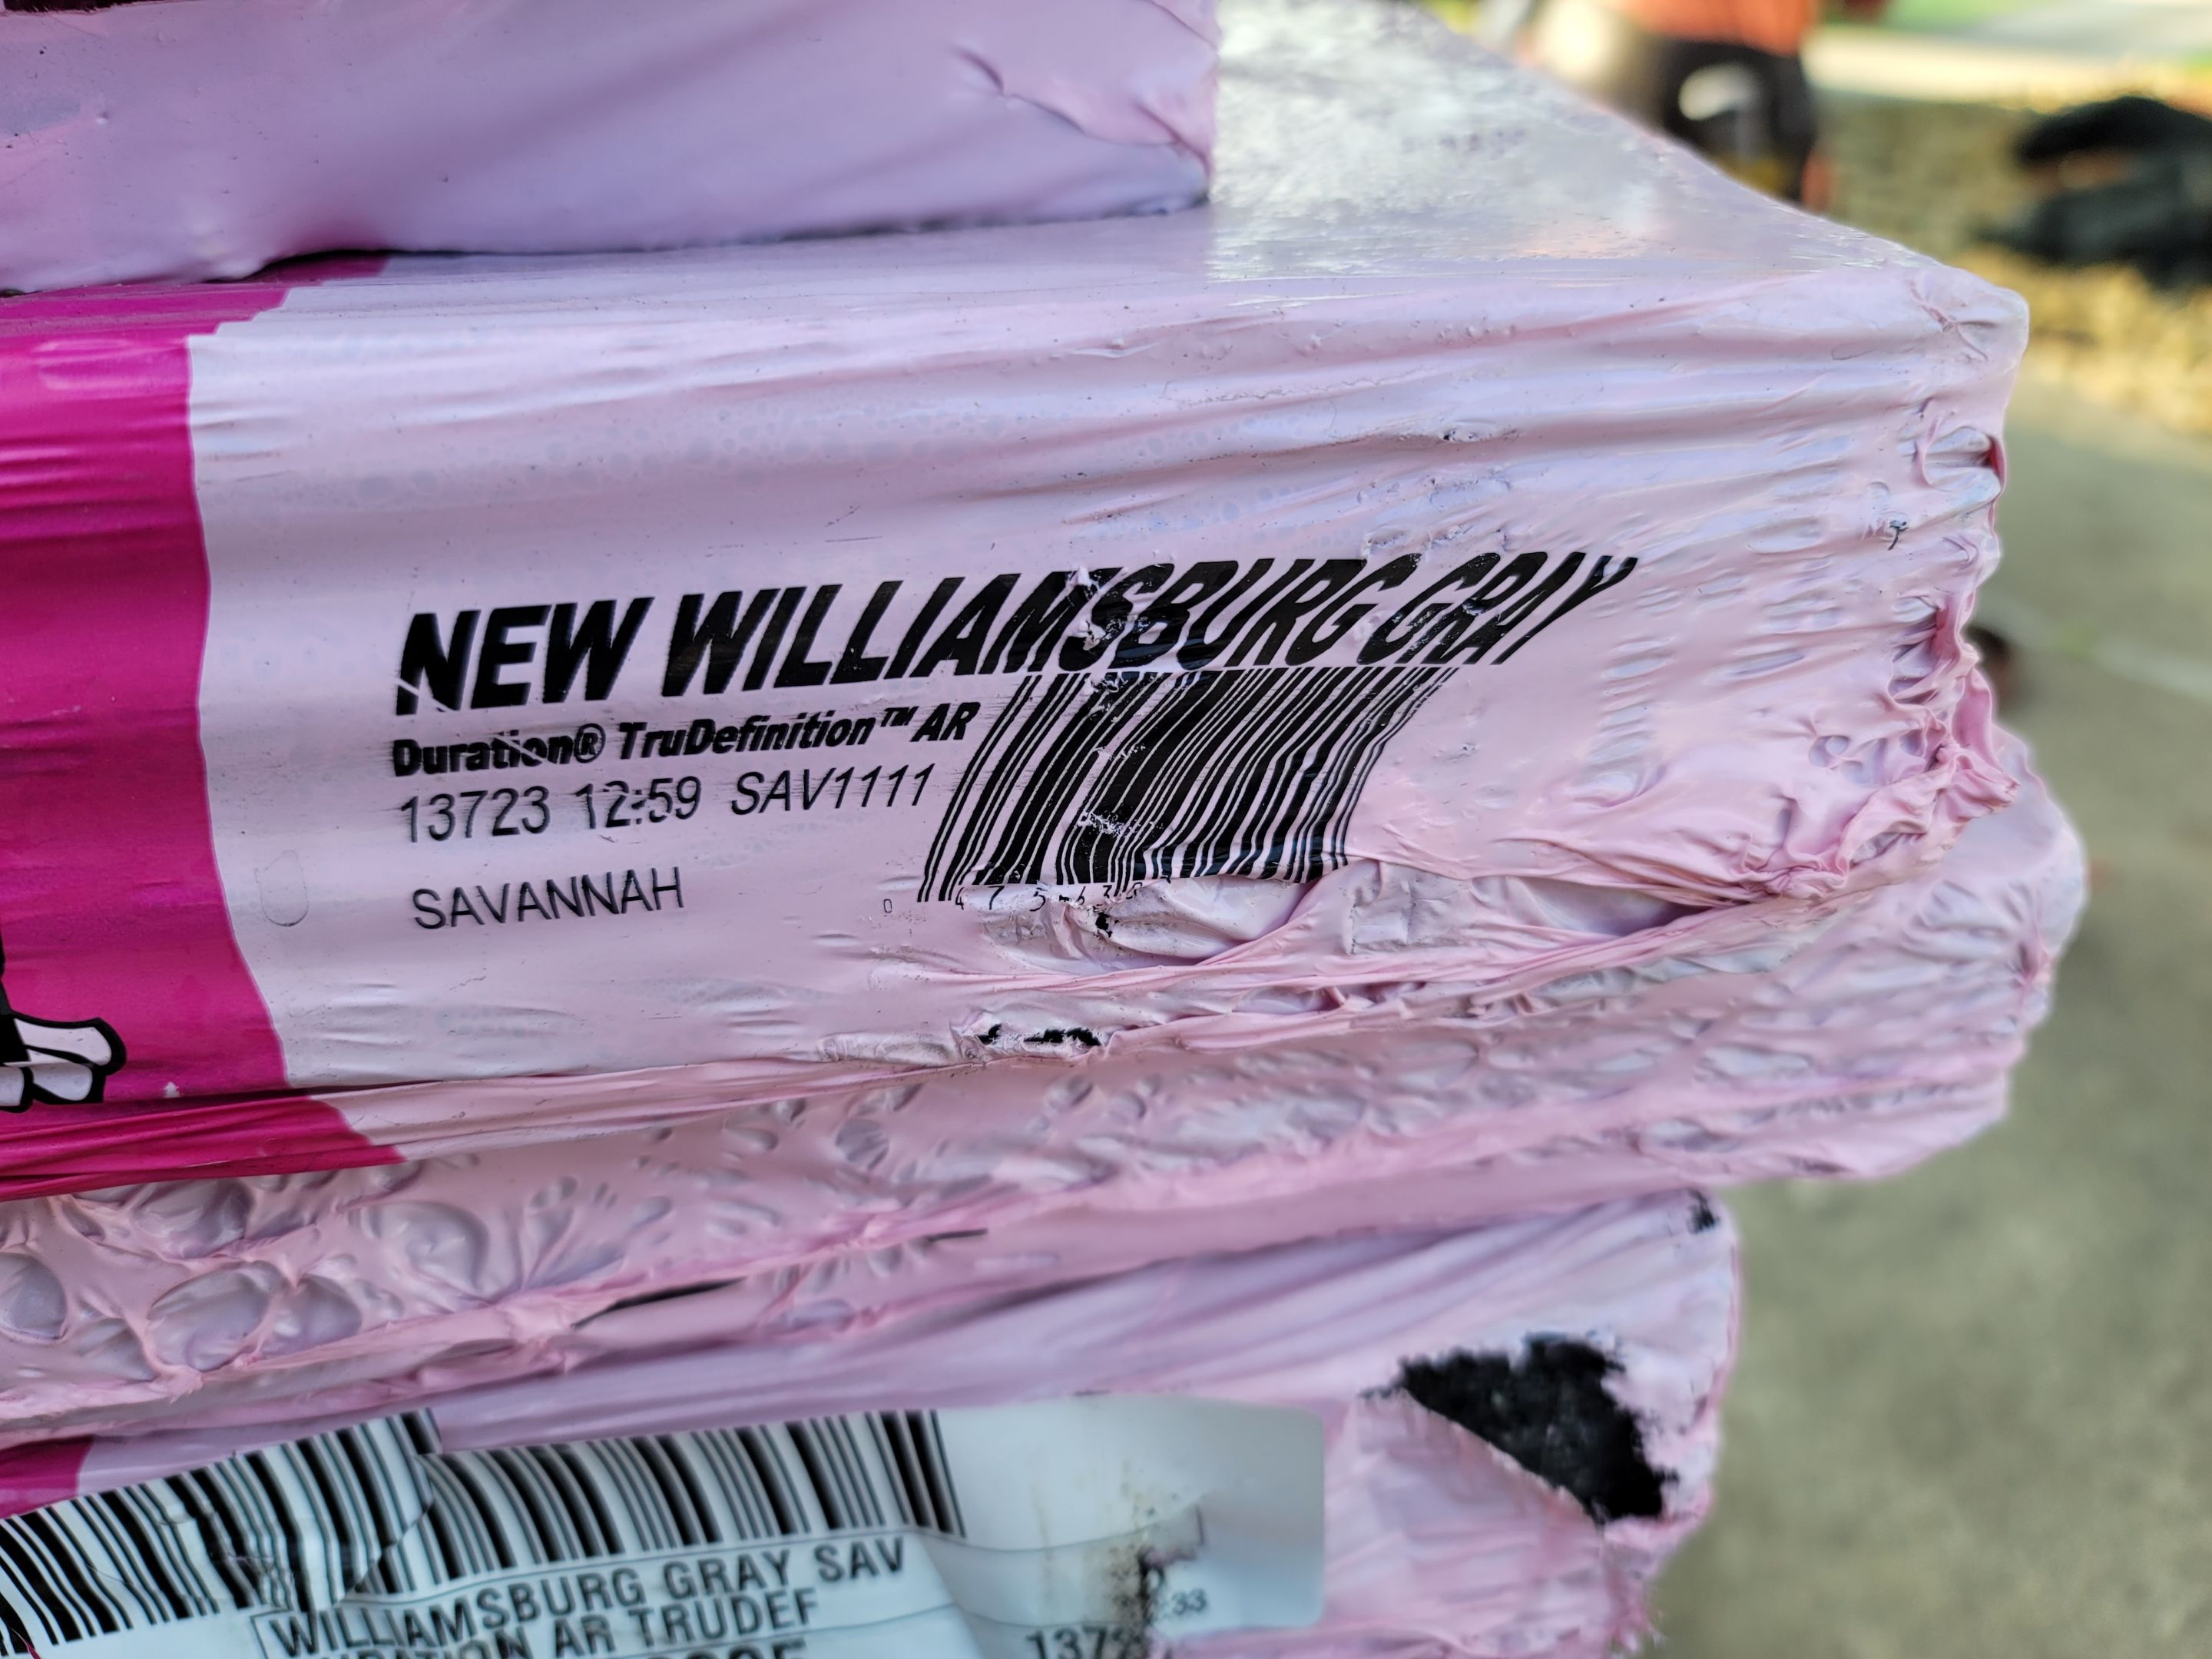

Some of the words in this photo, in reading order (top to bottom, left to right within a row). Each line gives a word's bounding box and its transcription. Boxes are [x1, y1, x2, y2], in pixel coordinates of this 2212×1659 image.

[396, 596, 656, 716] NEW
[661, 551, 1422, 697] WILLIAMSBURG
[1356, 551, 1639, 667] GRAY
[911, 701, 982, 743] AR
[401, 785, 552, 843] 13723
[575, 775, 702, 830] 12:59
[731, 763, 936, 816] SAV1111
[412, 866, 684, 930] SAVANNAH
[268, 1567, 647, 1658] WILLIAMSBURG
[663, 1548, 791, 1601] GRAY
[813, 1536, 905, 1583] SAV
[627, 1587, 820, 1648] TRUDEF
